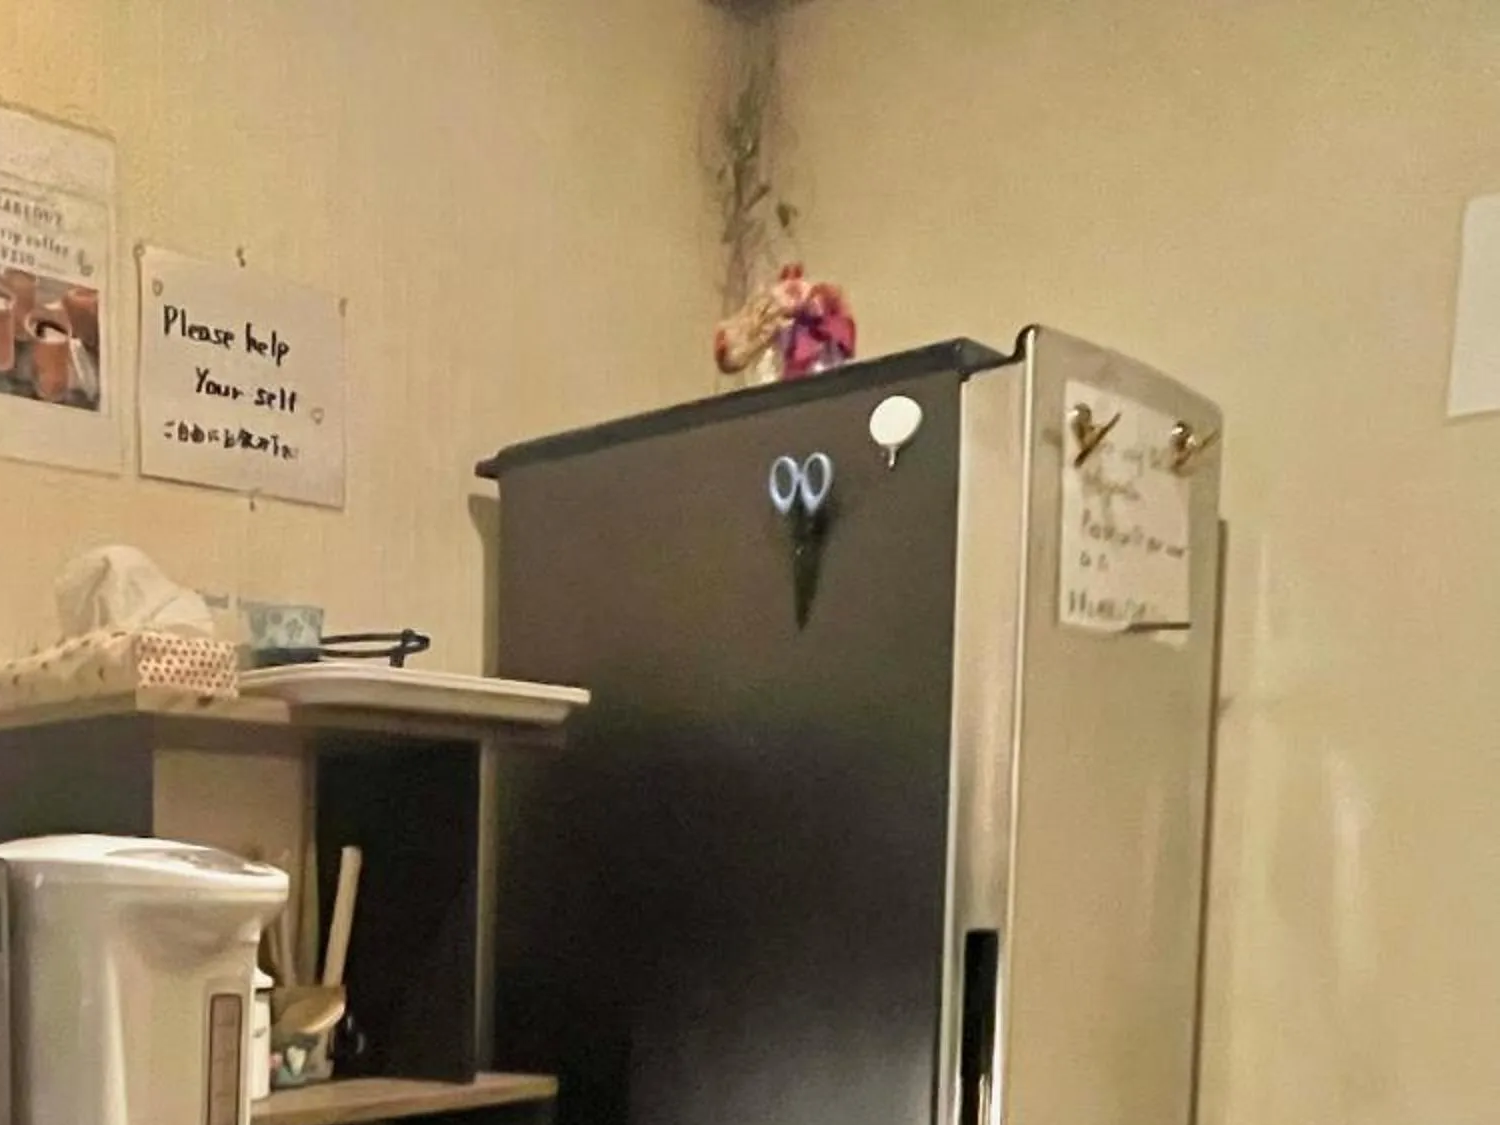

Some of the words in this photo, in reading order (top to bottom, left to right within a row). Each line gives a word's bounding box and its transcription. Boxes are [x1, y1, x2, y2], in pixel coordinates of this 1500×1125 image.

[163, 304, 235, 351] Please
[245, 322, 291, 367] help
[253, 387, 298, 413] self
